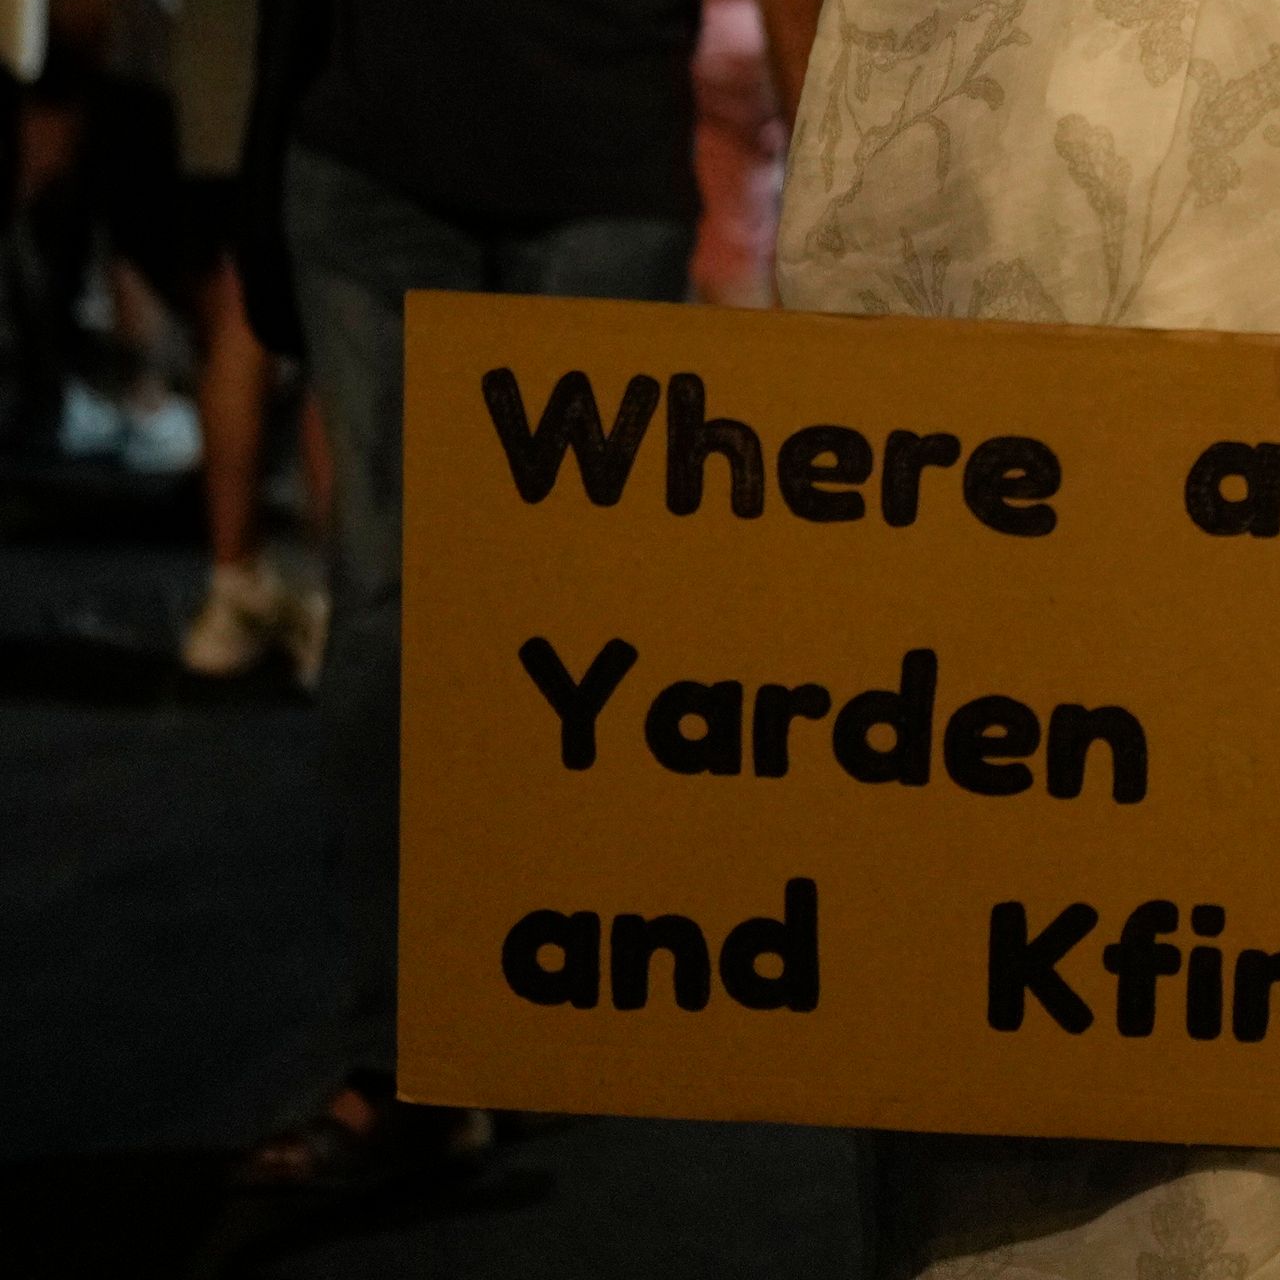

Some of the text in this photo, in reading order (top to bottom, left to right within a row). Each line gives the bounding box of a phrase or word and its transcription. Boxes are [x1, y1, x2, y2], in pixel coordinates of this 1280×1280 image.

[481, 367, 1063, 537] Where
[518, 635, 1149, 805] Yarden
[501, 876, 821, 1013] and
